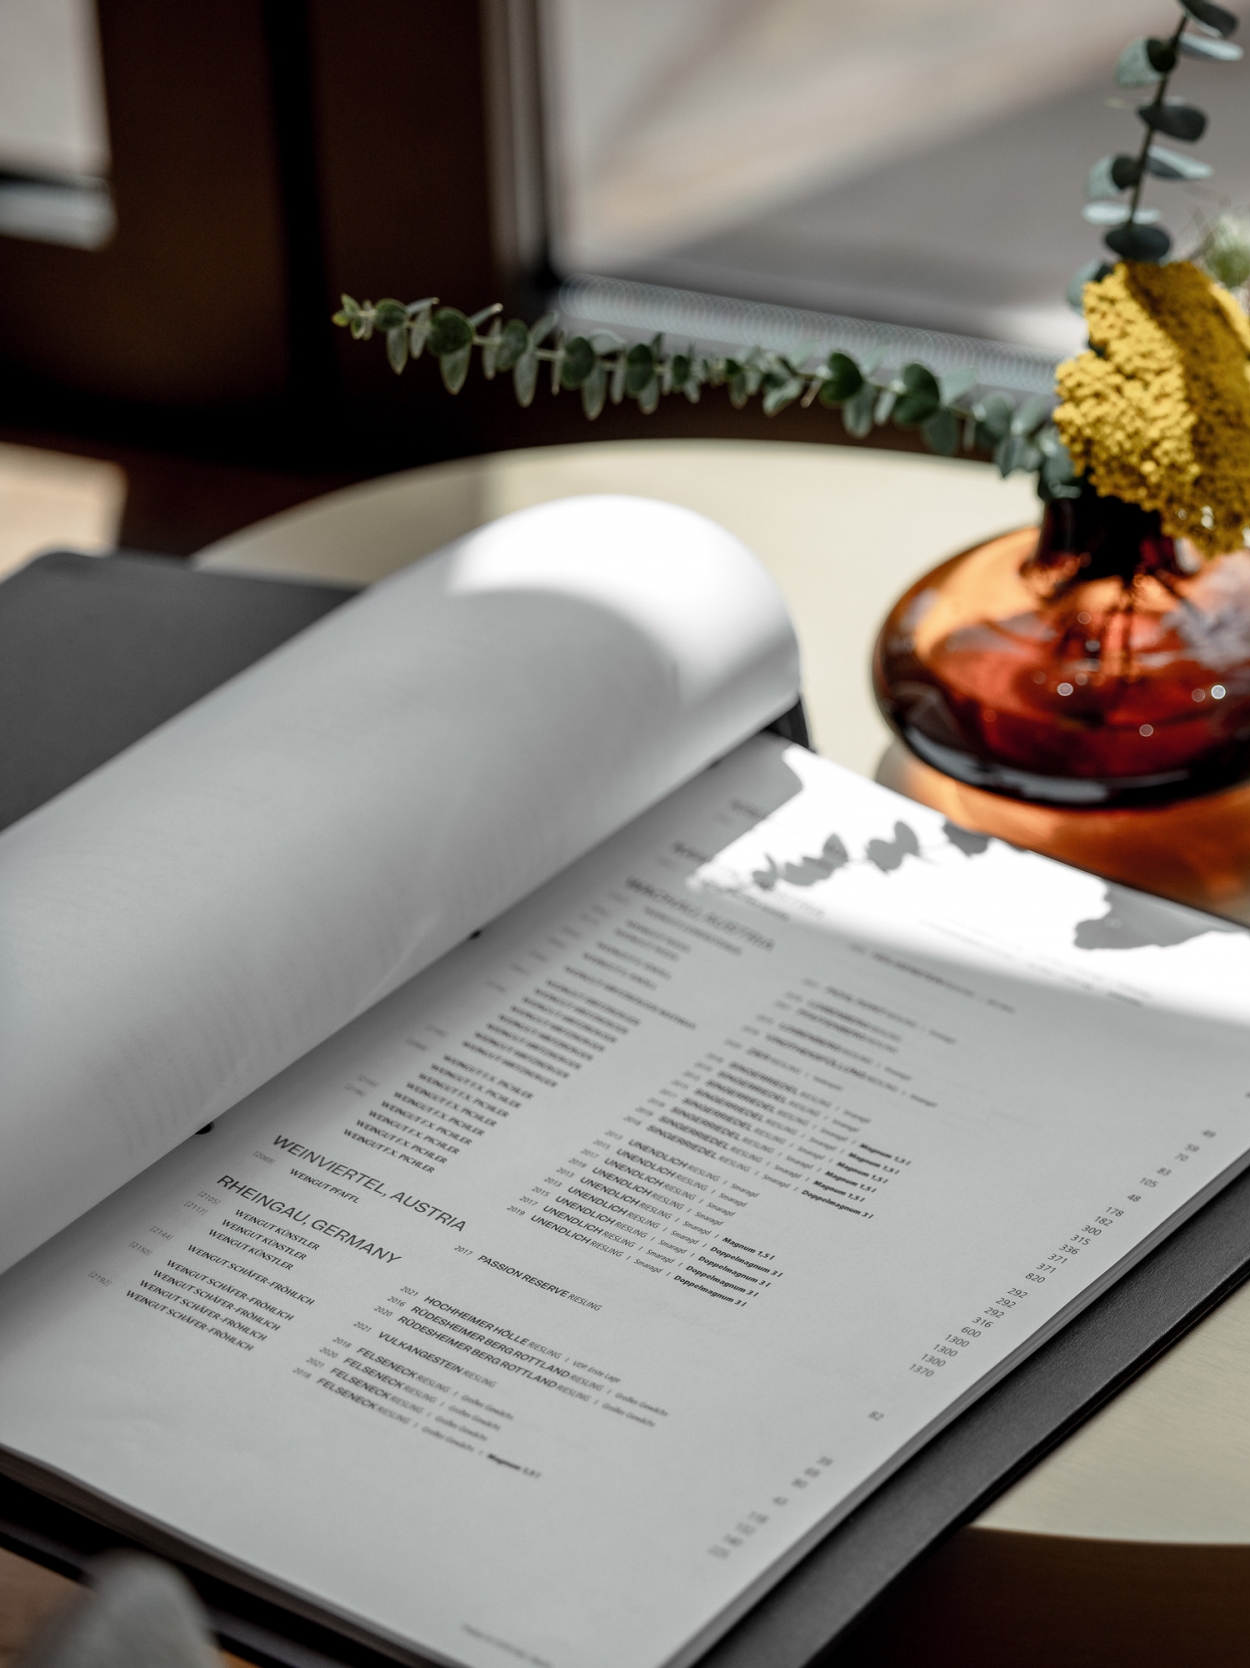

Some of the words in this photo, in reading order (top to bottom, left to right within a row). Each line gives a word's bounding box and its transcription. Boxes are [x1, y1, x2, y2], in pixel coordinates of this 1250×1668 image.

[344, 1129, 384, 1149] WEINGUT
[398, 1153, 435, 1173] PICHLER
[356, 1119, 397, 1140] WEINGUT
[410, 1144, 447, 1164] PICHLER
[628, 1139, 689, 1168] UNENDLICH
[273, 1135, 386, 1197] WEINVIERTEL,
[389, 1192, 466, 1231] AUSTRIA
[616, 1148, 676, 1177] UNENDLICH
[672, 1173, 709, 1191] RIESLING
[290, 1168, 331, 1189] WEINGUT
[329, 1186, 359, 1203] PFAFFL
[592, 1167, 653, 1196] UNENDLICH
[650, 1192, 685, 1210] RIESLING
[694, 1211, 724, 1226] Smaragd
[604, 1158, 665, 1186] UNENDLICH
[662, 1183, 697, 1200] RIESLING
[706, 1202, 736, 1216] Smaragd
[813, 1180, 846, 1195] Magnum
[580, 1176, 640, 1205] UNENDLICH
[638, 1202, 672, 1219] RIESLING
[682, 1220, 712, 1235] Smaragd
[722, 1237, 756, 1253] Magnum
[801, 1189, 861, 1215] Doppelmagnum
[1105, 1206, 1124, 1217] 178
[216, 1175, 310, 1225] RHEINGAU,
[311, 1219, 402, 1263] GERMANY
[235, 1209, 277, 1230] WEINGUT
[274, 1227, 320, 1250] KÜNSTLER
[543, 1176, 562, 1187] 2013
[567, 1186, 628, 1215] UNENDLICH
[626, 1211, 660, 1228] RIESLING
[670, 1230, 700, 1244] Smaragd
[710, 1246, 770, 1273] Doppelmagnum
[1081, 1225, 1102, 1235] 300
[1095, 1216, 1113, 1226] 182
[209, 1229, 250, 1250] WEINGUT
[248, 1247, 293, 1270] KÜNSTLER
[222, 1219, 264, 1240] WEINGUT
[261, 1237, 307, 1260] KÜNSTLER
[519, 1195, 538, 1206] 2017
[543, 1205, 604, 1234] UNENDLICH
[601, 1231, 636, 1247] RIESLING
[646, 1249, 675, 1263] Smaragd
[686, 1265, 746, 1292] Doppelmagnum
[531, 1186, 550, 1197] 2015
[555, 1196, 616, 1224] UNENDLICH
[613, 1221, 648, 1238] RIESLING
[658, 1239, 687, 1254] Smaragd
[698, 1256, 758, 1283] Doppelmagnum
[1059, 1244, 1080, 1254] 336
[1070, 1234, 1091, 1245] 315
[188, 1244, 230, 1265] WEINGUT
[506, 1205, 525, 1216] 2019
[530, 1215, 592, 1243] UNENDLICH
[589, 1240, 624, 1257] RIESLING
[633, 1258, 663, 1273] Smaragd
[673, 1275, 734, 1302] Doppelmagnum
[1036, 1263, 1056, 1273] 371
[1047, 1253, 1067, 1264] 371
[153, 1270, 195, 1291] WEINGUT
[167, 1260, 209, 1281] WEINGUT
[454, 1245, 473, 1255] 2017
[477, 1255, 523, 1277] PASSION
[521, 1274, 570, 1297] RESERVE
[567, 1293, 602, 1311] RIESLING
[1025, 1272, 1045, 1283] 820
[126, 1290, 168, 1311] WEINGUT
[140, 1280, 182, 1301] WEINGUT
[995, 1297, 1016, 1308] 292
[1007, 1287, 1028, 1298] 292
[400, 1286, 418, 1296] 2021
[424, 1296, 494, 1330] HOCHHEIMER
[492, 1326, 529, 1345] HÖLLE
[527, 1341, 562, 1359] RIESLING
[972, 1316, 993, 1327] 316
[984, 1307, 1004, 1318] 292
[387, 1296, 406, 1307] 2016
[410, 1306, 485, 1342] RÜDESHEIMER
[483, 1338, 514, 1354] BERG
[512, 1350, 570, 1377] ROTTLAND
[568, 1374, 604, 1391] RIESLING
[945, 1334, 970, 1347] 1300
[961, 1326, 981, 1337] 600
[332, 1337, 352, 1348] 2018
[356, 1347, 418, 1378] FELSENECK
[415, 1374, 451, 1393] RIESLING
[353, 1321, 372, 1332] 2021
[378, 1331, 464, 1373] VULKANGESTEIN
[461, 1369, 497, 1387] RIESLING
[373, 1305, 393, 1316] 2020
[397, 1316, 472, 1352] RÜDESHEIMER
[470, 1348, 501, 1365] BERG
[499, 1360, 557, 1387] ROTTLAND
[555, 1384, 591, 1401] RIESLING
[921, 1353, 946, 1367] 1300
[933, 1344, 958, 1357] 1300
[305, 1357, 325, 1368] 2021
[330, 1367, 391, 1399] FELSENECK
[319, 1347, 338, 1358] 2020
[343, 1357, 405, 1388] FELSENECK
[909, 1363, 934, 1377] 1370
[316, 1378, 378, 1409] FELSENECK
